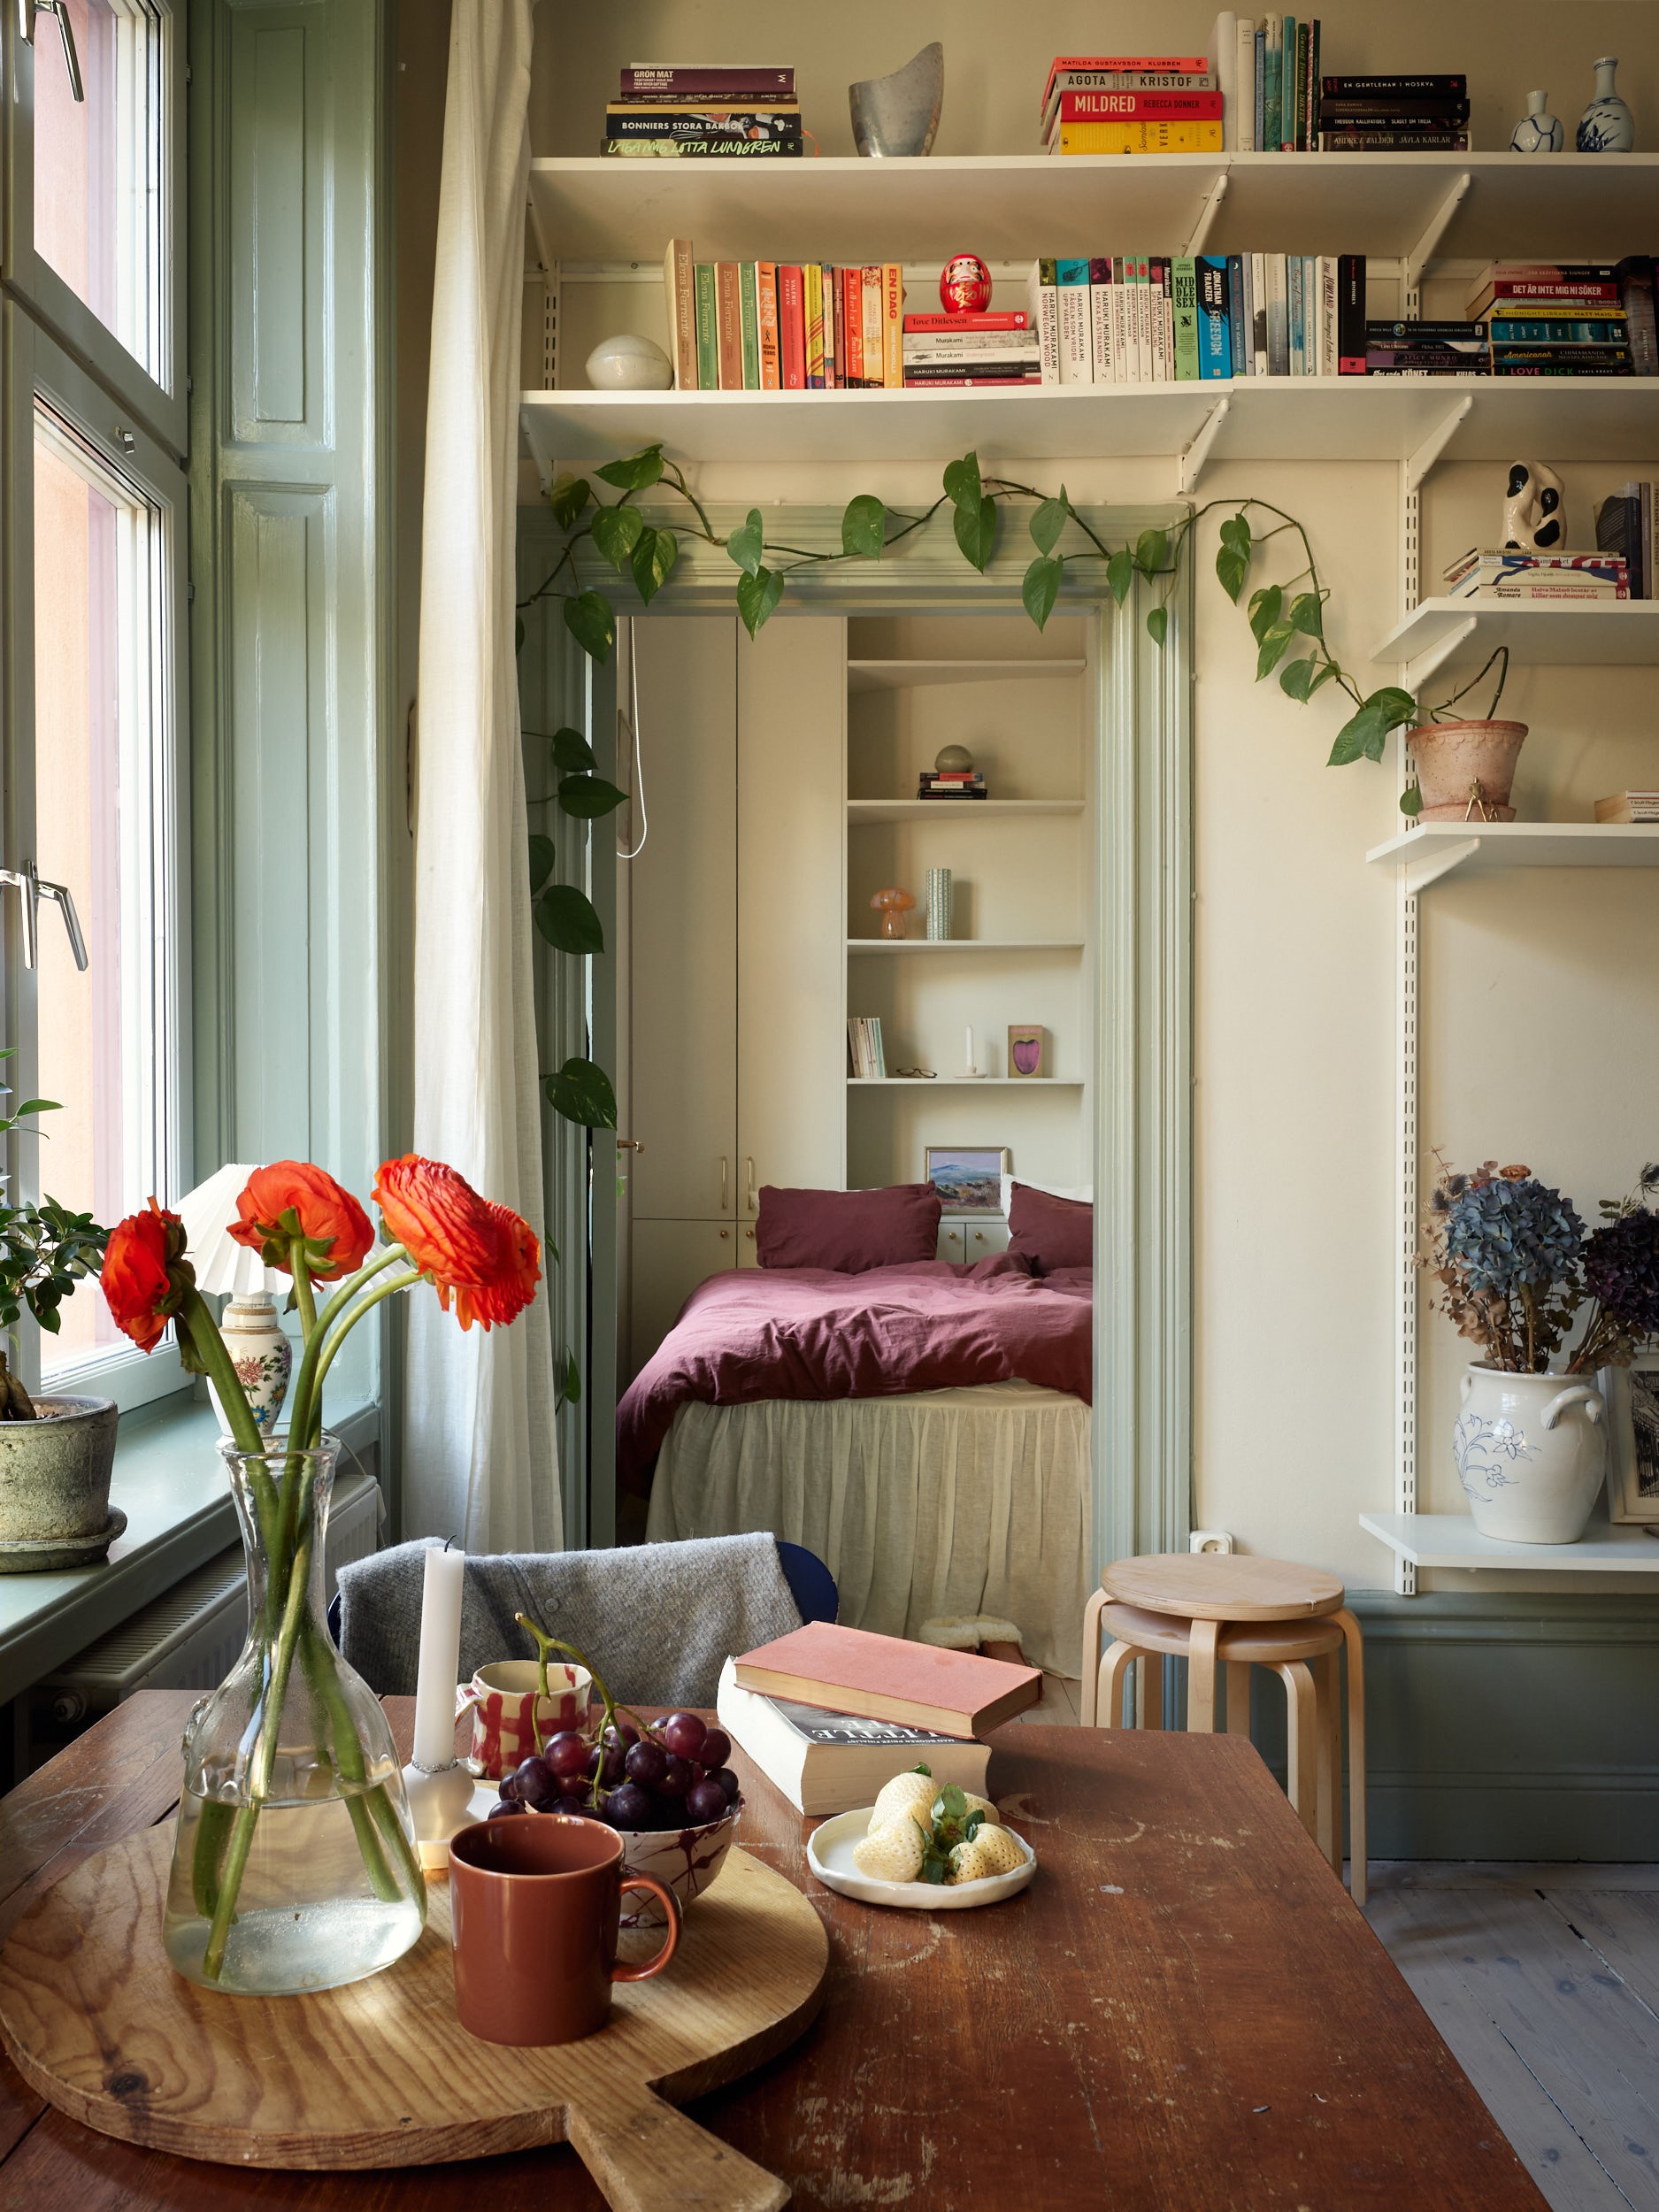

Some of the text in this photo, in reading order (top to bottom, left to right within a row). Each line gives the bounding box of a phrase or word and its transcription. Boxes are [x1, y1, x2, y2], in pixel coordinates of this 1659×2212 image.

[1068, 76, 1106, 86] AGOTA
[1140, 76, 1192, 87] KRISTOF
[1075, 96, 1200, 112] MILDRED REBECCA DONNER
[670, 140, 781, 154] LOTTA LUNDGREN
[1159, 123, 1168, 146] VERK
[678, 253, 688, 284] Elena
[889, 269, 897, 288] EN
[1175, 277, 1194, 286] MID
[701, 272, 709, 299] Elena
[724, 270, 732, 298] Elena
[743, 269, 752, 297] Elena
[1176, 287, 1195, 297] DLE
[1204, 272, 1213, 302] FRANZEN
[1212, 270, 1222, 305] JONATHAN
[1292, 286, 1300, 294] of
[1323, 275, 1335, 308] LOWLAND
[1513, 284, 1602, 295] DET ÄR INTE MIG NI SÖKER
[680, 288, 690, 337] Ferrante
[1176, 298, 1195, 308] SEX
[701, 302, 710, 344] Ferrante
[724, 300, 733, 342] Ferrante
[744, 299, 753, 341] Ferrante
[1096, 316, 1103, 325] PÅ
[1209, 310, 1222, 356] FREEDOM
[1325, 310, 1334, 339] Jhumpa
